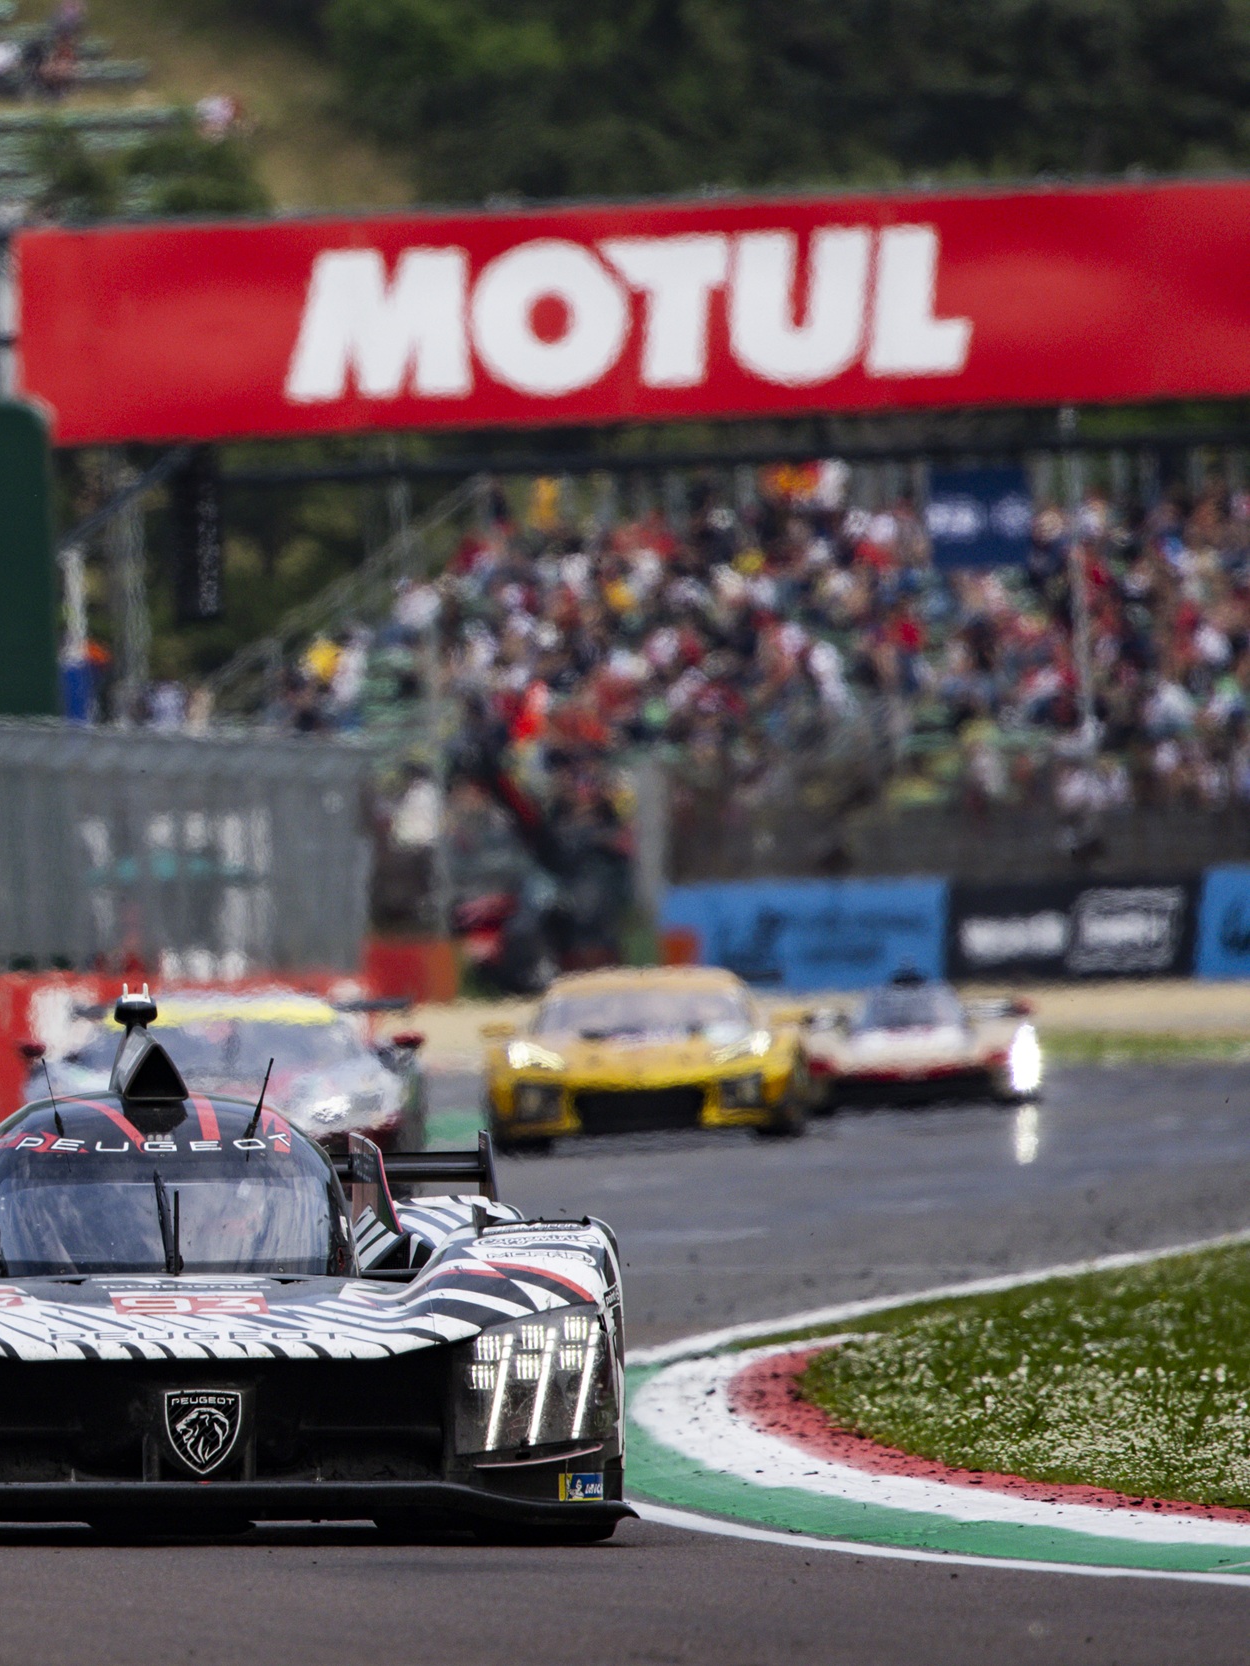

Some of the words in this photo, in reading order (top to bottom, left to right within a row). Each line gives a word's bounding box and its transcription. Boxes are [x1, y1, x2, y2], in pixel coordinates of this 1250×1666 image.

[285, 224, 973, 402] MOTUL
[15, 1132, 291, 1153] PEUGEOT
[481, 1234, 579, 1247] Capgemini
[120, 1297, 261, 1313] 93
[50, 1331, 349, 1341] PEUGEOT
[171, 1396, 235, 1406] PEUGEOT
